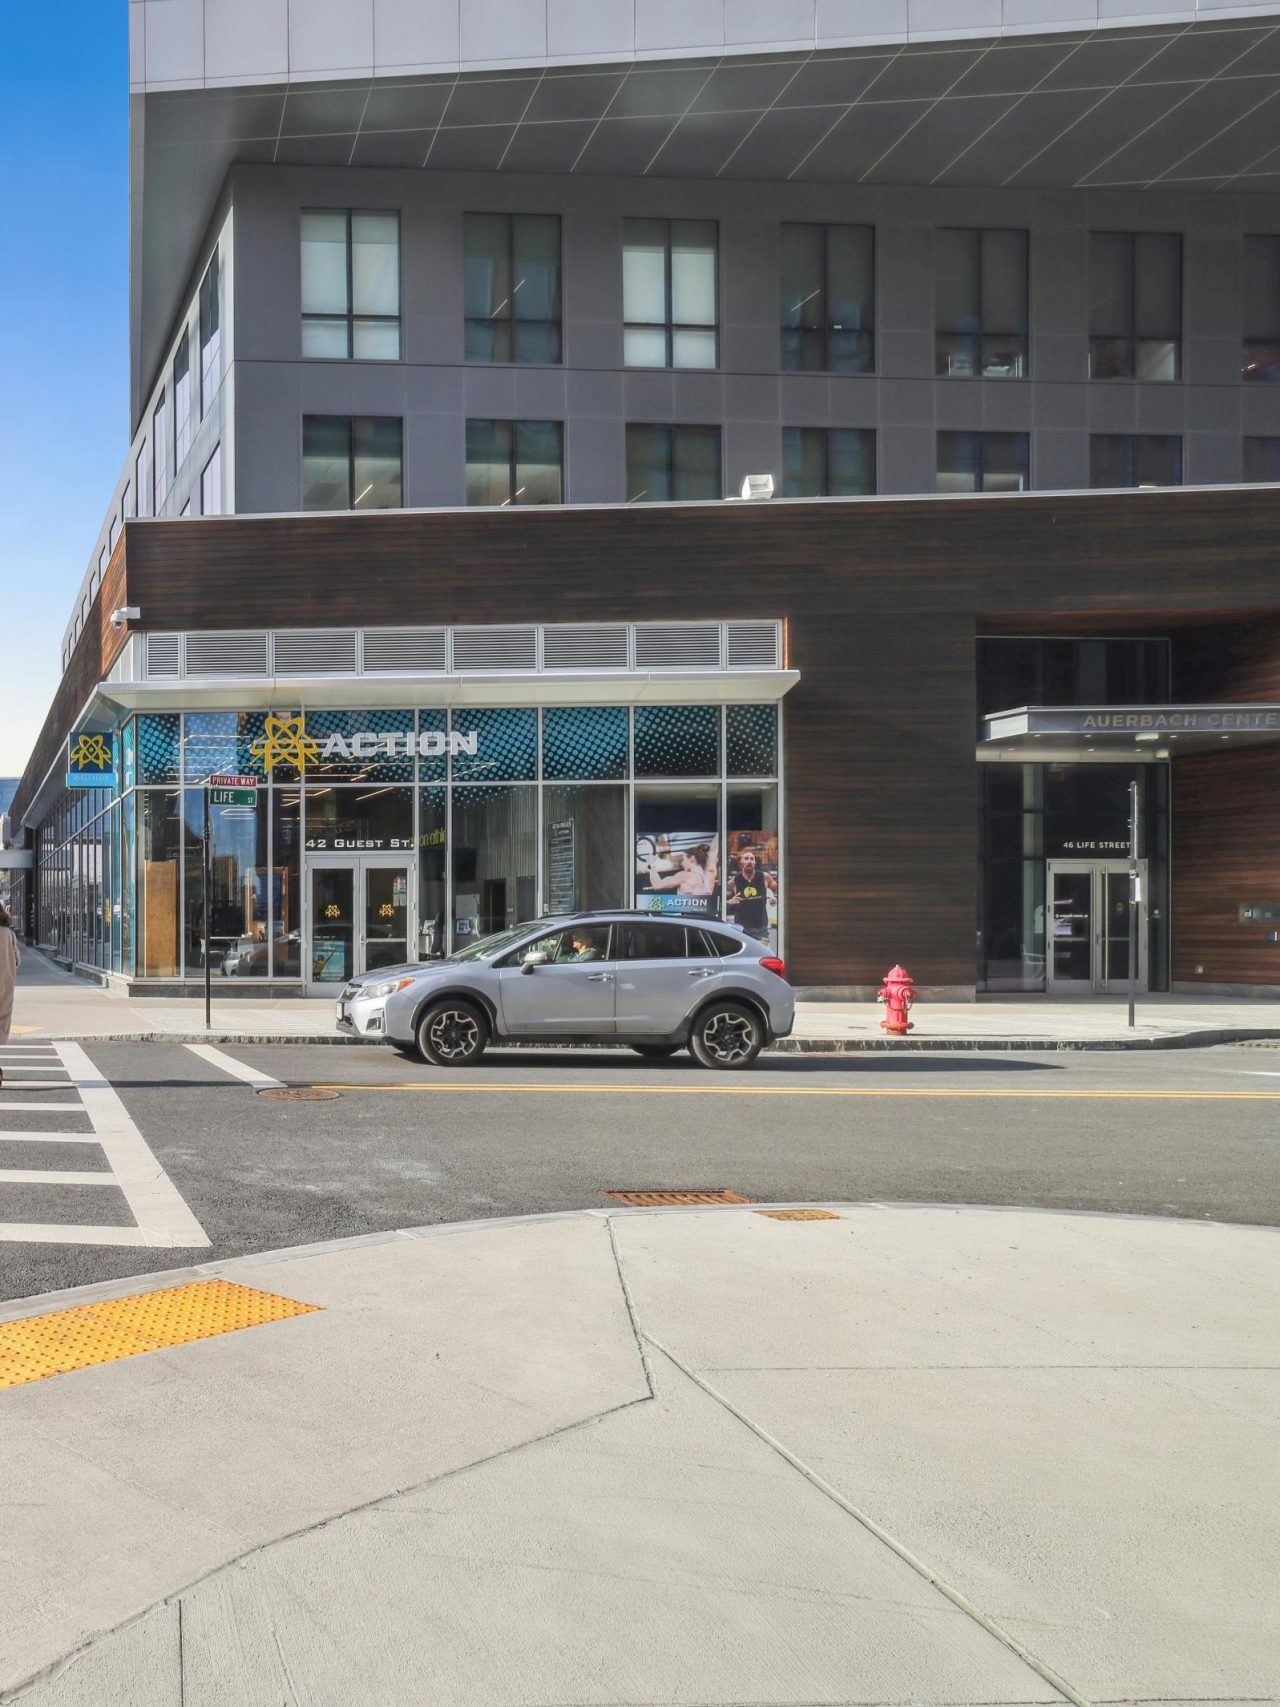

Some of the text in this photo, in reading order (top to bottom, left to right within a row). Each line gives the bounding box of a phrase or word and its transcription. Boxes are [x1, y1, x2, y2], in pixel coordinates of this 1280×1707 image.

[1083, 713, 1277, 727] AUERBACH CENTE
[322, 731, 478, 757] ACTION
[212, 776, 255, 786] PRIVATE WAY
[214, 791, 234, 803] LIFE
[306, 839, 327, 848] 42
[1063, 841, 1131, 849] 46 LIFE STREET
